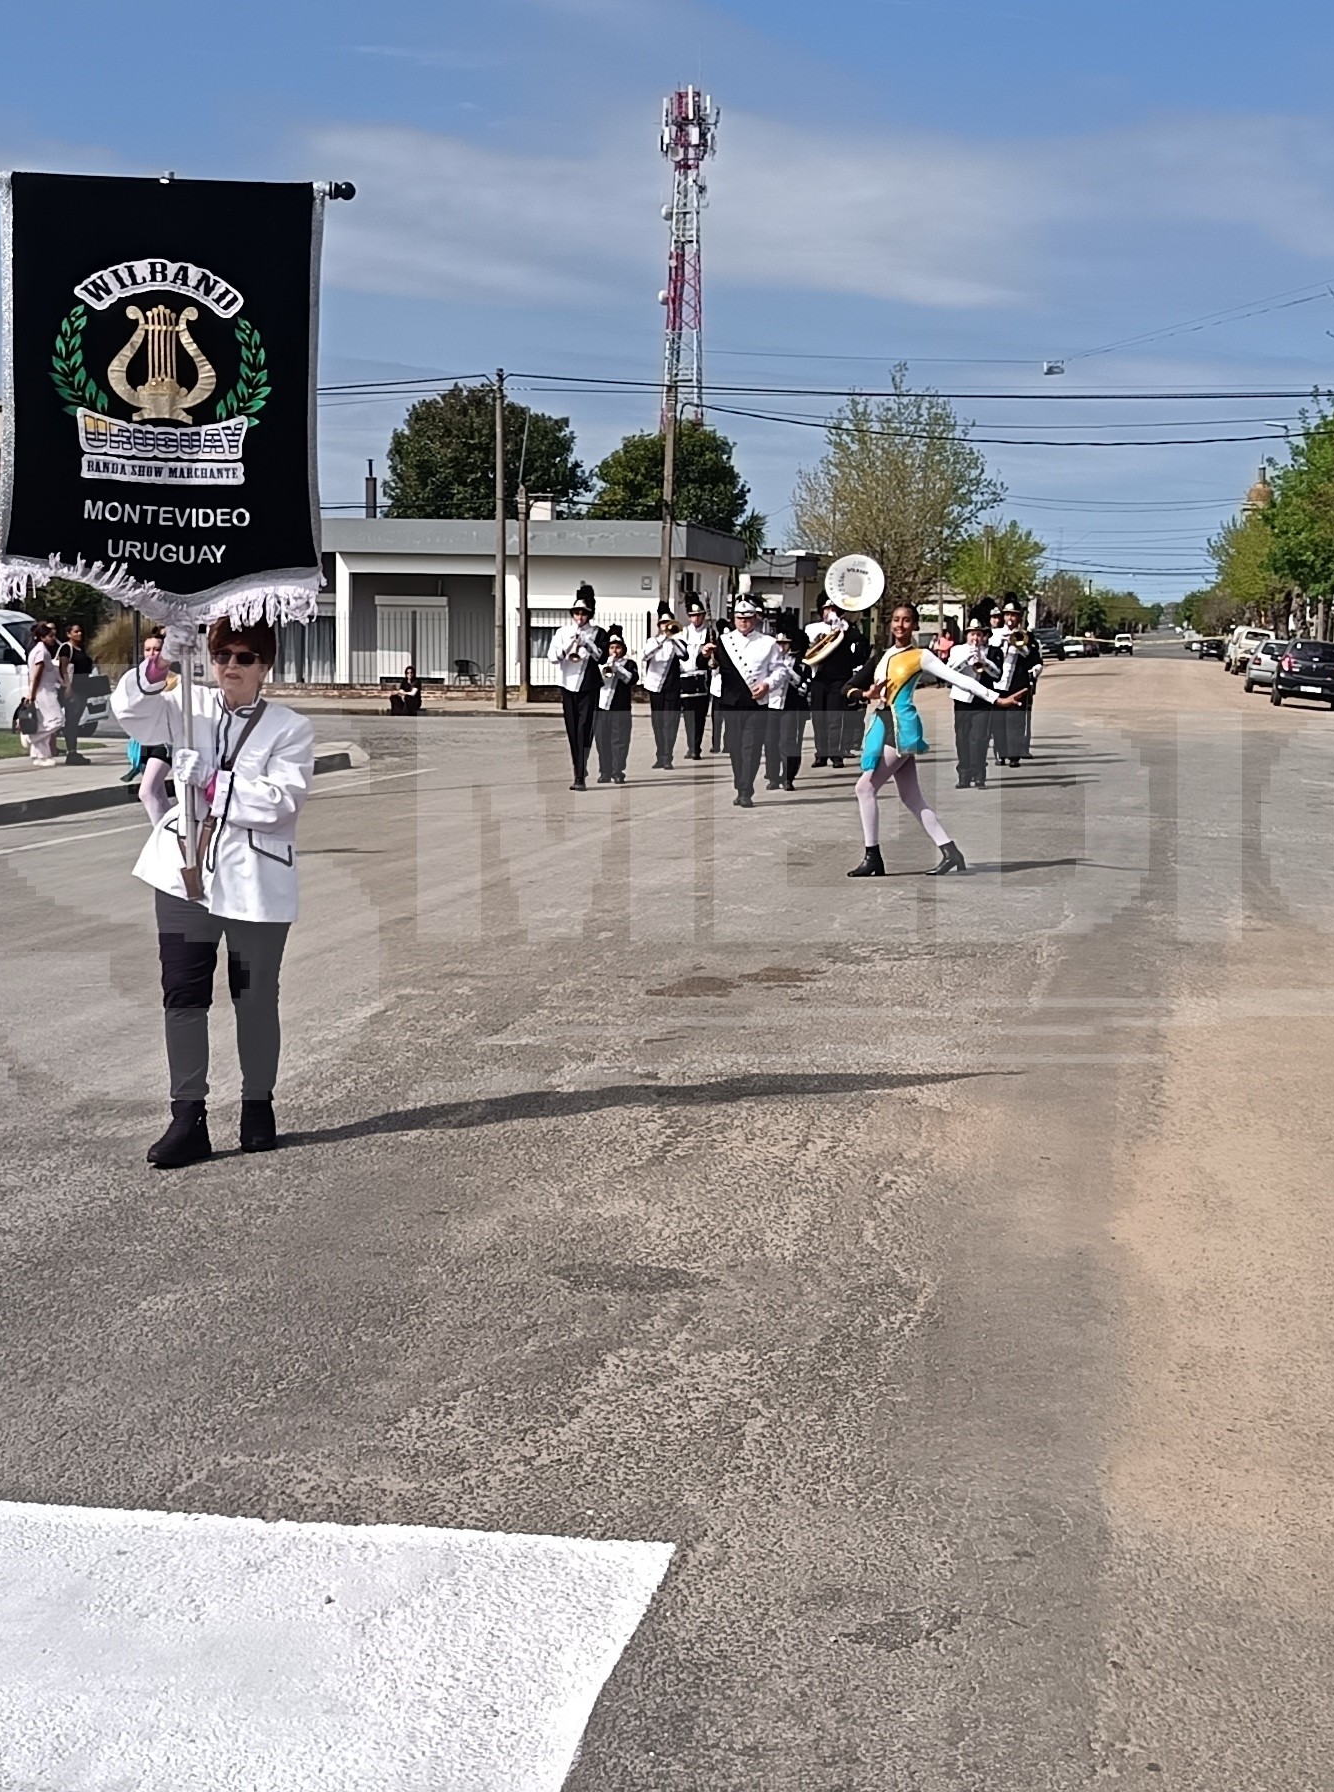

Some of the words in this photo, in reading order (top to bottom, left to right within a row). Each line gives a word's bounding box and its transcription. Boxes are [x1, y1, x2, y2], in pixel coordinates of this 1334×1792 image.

[80, 260, 240, 312] WILBAND
[83, 413, 245, 455] URUGUAY
[86, 460, 128, 476] BANDA
[130, 464, 164, 478] SHOW
[168, 466, 239, 479] MARCHANTE
[83, 499, 251, 528] MONTEVIDEO
[107, 538, 227, 564] URUGUAY
